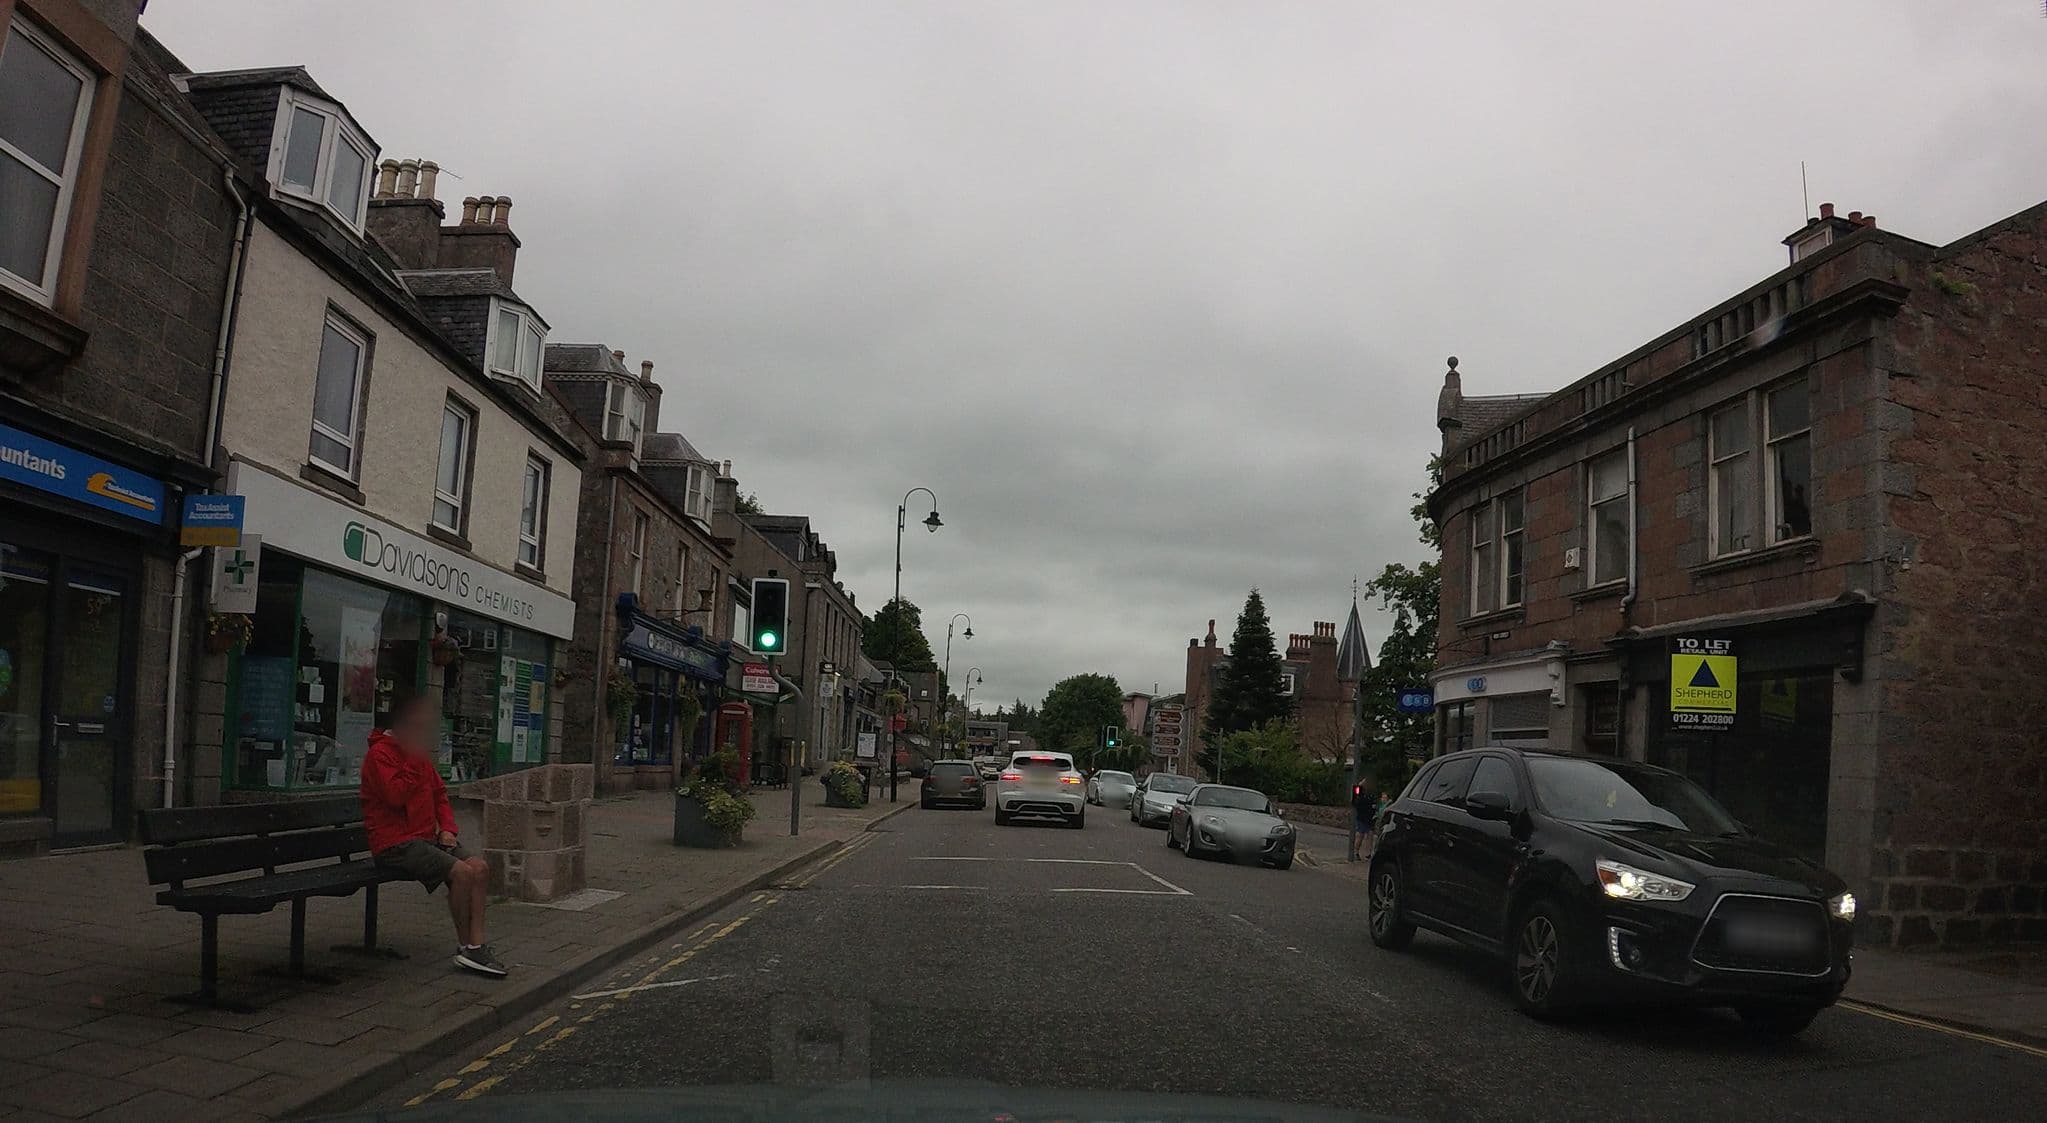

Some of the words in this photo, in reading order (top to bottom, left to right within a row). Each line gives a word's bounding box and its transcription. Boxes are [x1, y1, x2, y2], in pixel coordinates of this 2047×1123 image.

[0, 446, 66, 480] untants
[361, 526, 470, 598] Davidsons
[475, 585, 534, 620] CHEMISTS
[1676, 638, 1699, 648] TO
[1705, 639, 1732, 650] LET
[1675, 687, 1733, 699] SHEPHERD
[1673, 713, 1699, 723] 01224
[1702, 714, 1734, 725] 202800
